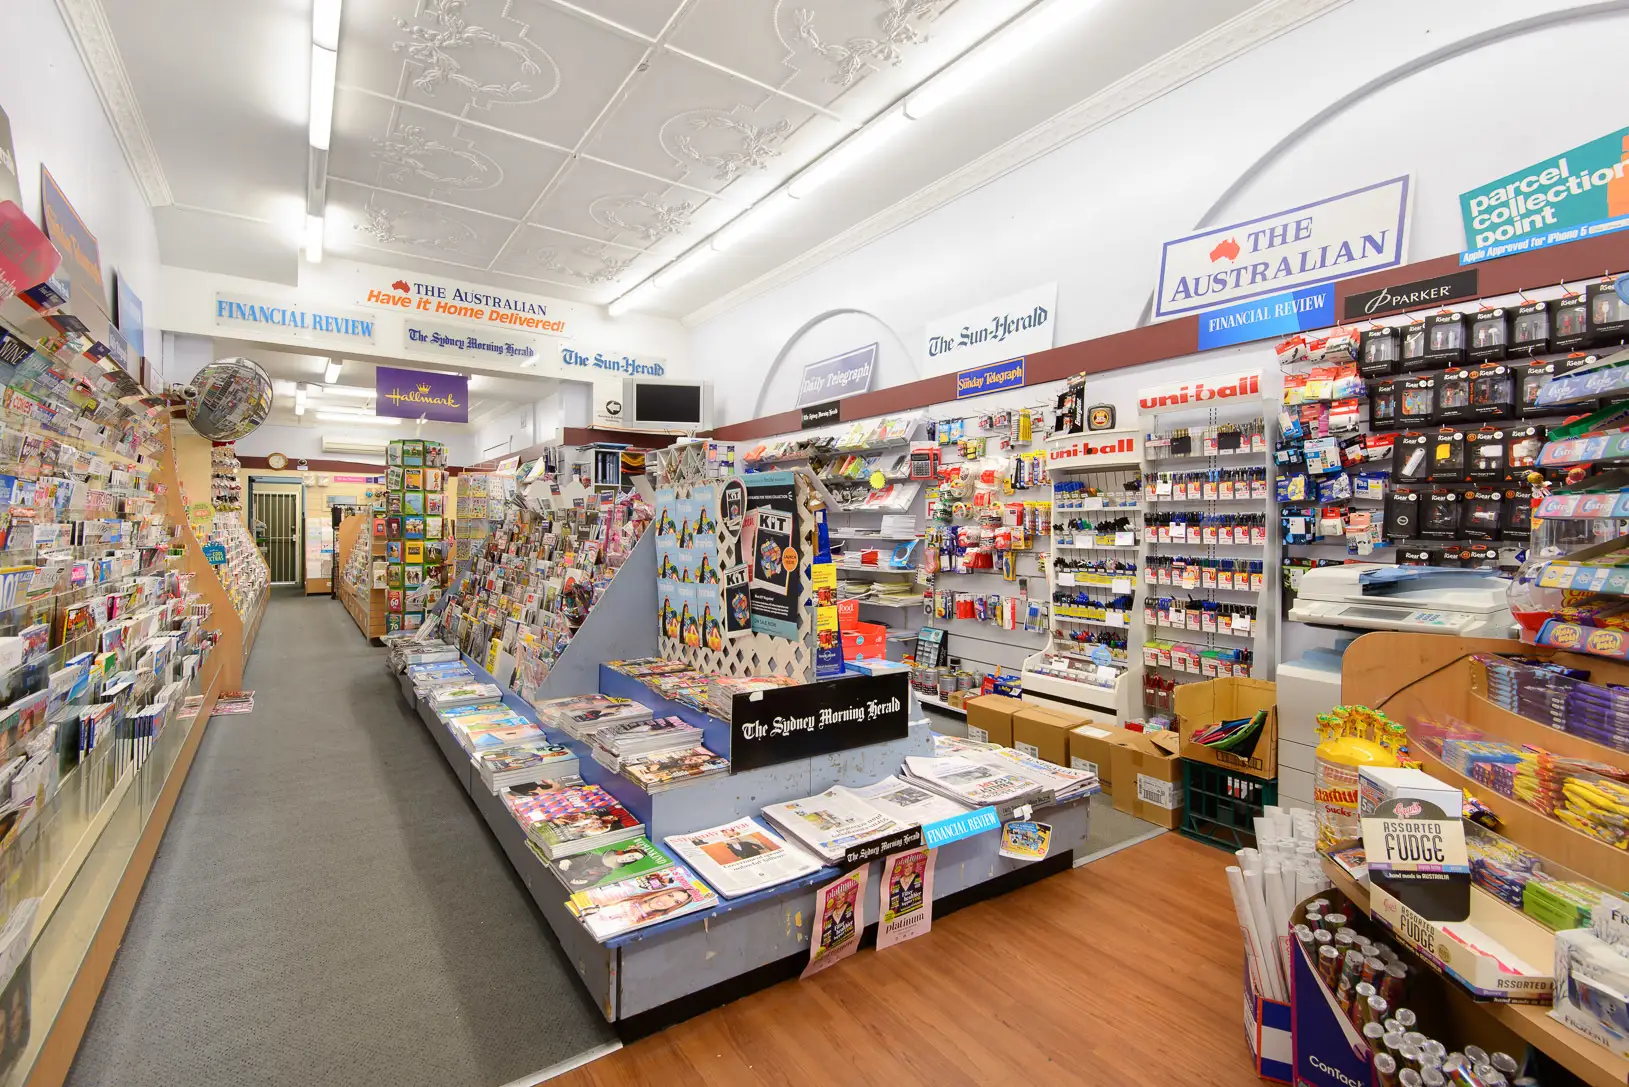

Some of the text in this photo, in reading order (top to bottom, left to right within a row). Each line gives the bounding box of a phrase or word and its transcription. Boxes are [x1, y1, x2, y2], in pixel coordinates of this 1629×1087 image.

[1469, 157, 1569, 218] parcel
[1247, 216, 1313, 252] THE
[1475, 205, 1558, 249] point
[1463, 249, 1485, 263] Apple
[1487, 239, 1529, 257] Approved
[1531, 236, 1546, 248] for
[1170, 229, 1390, 303] AUSTRALIAN
[367, 289, 566, 333] Have it Home Delivered!
[413, 282, 547, 316] THE AUSTRALIAN
[1208, 292, 1326, 332] FINANCIAL REVIEW
[1392, 286, 1450, 306] PARKER
[216, 299, 375, 338] FINANCIAL REVIEW
[928, 305, 1048, 357] The Sun-Herald
[408, 328, 535, 358] The Sydney Morning Herald
[562, 348, 665, 377] The Sun-Herald
[801, 362, 870, 394] Daily Telegraph
[958, 366, 1022, 391] Sunday Telegraph
[384, 389, 460, 408] Hallmark
[1139, 375, 1260, 409] uni-ball
[1050, 438, 1134, 461] uni-ball
[390, 598, 399, 607] 60
[741, 696, 901, 741] The Sydney Morning Herald
[926, 820, 966, 844] FINANCIAL
[966, 810, 997, 834] REVIEW
[1383, 821, 1442, 835] ASSORTED
[846, 831, 921, 863] The Sydney Morning Herald
[1384, 833, 1445, 863] FUDGE
[885, 912, 925, 934] platinum
[1400, 914, 1435, 954] FUDGE
[1401, 905, 1435, 935] ASSORTED
[1497, 979, 1547, 990] ASSORTED
